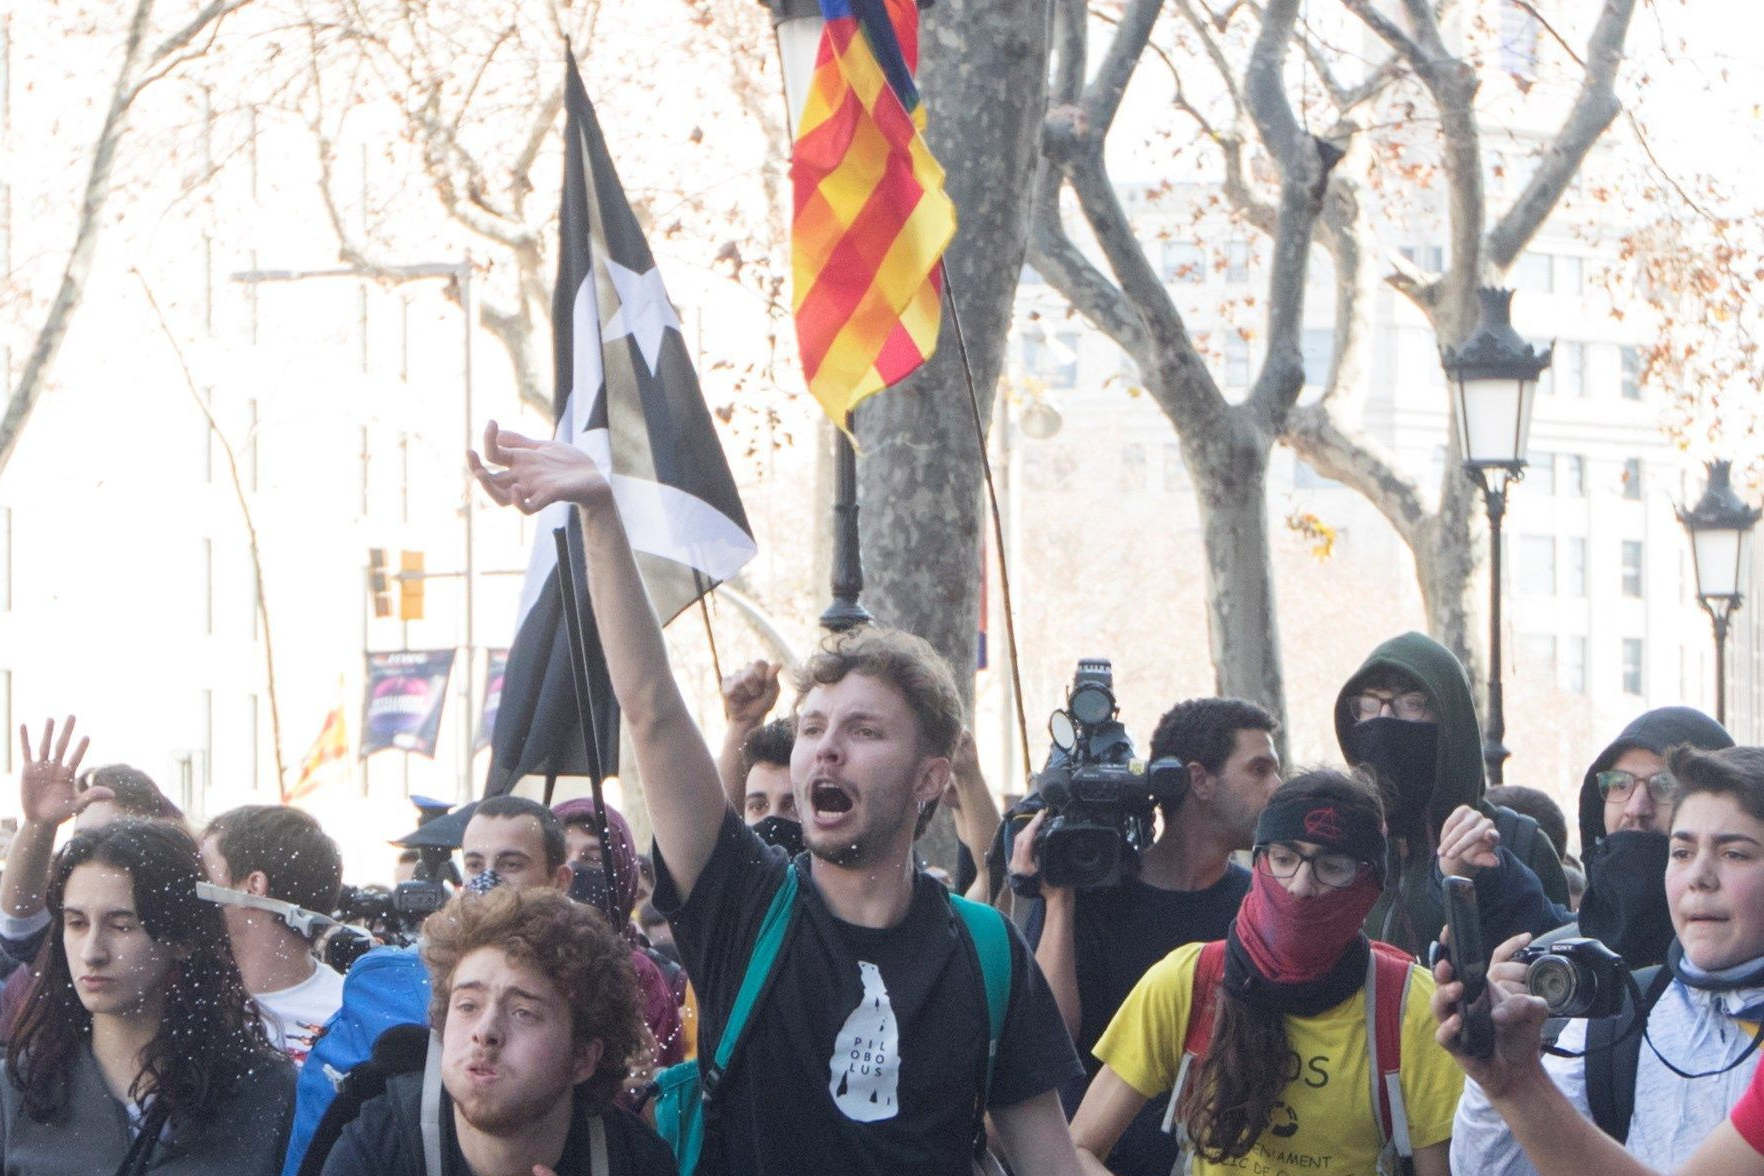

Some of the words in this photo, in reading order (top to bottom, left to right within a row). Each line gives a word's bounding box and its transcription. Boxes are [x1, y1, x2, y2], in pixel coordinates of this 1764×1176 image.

[853, 1036, 885, 1051] PIL
[850, 1049, 885, 1064] OBO
[849, 1062, 882, 1077] LUS
